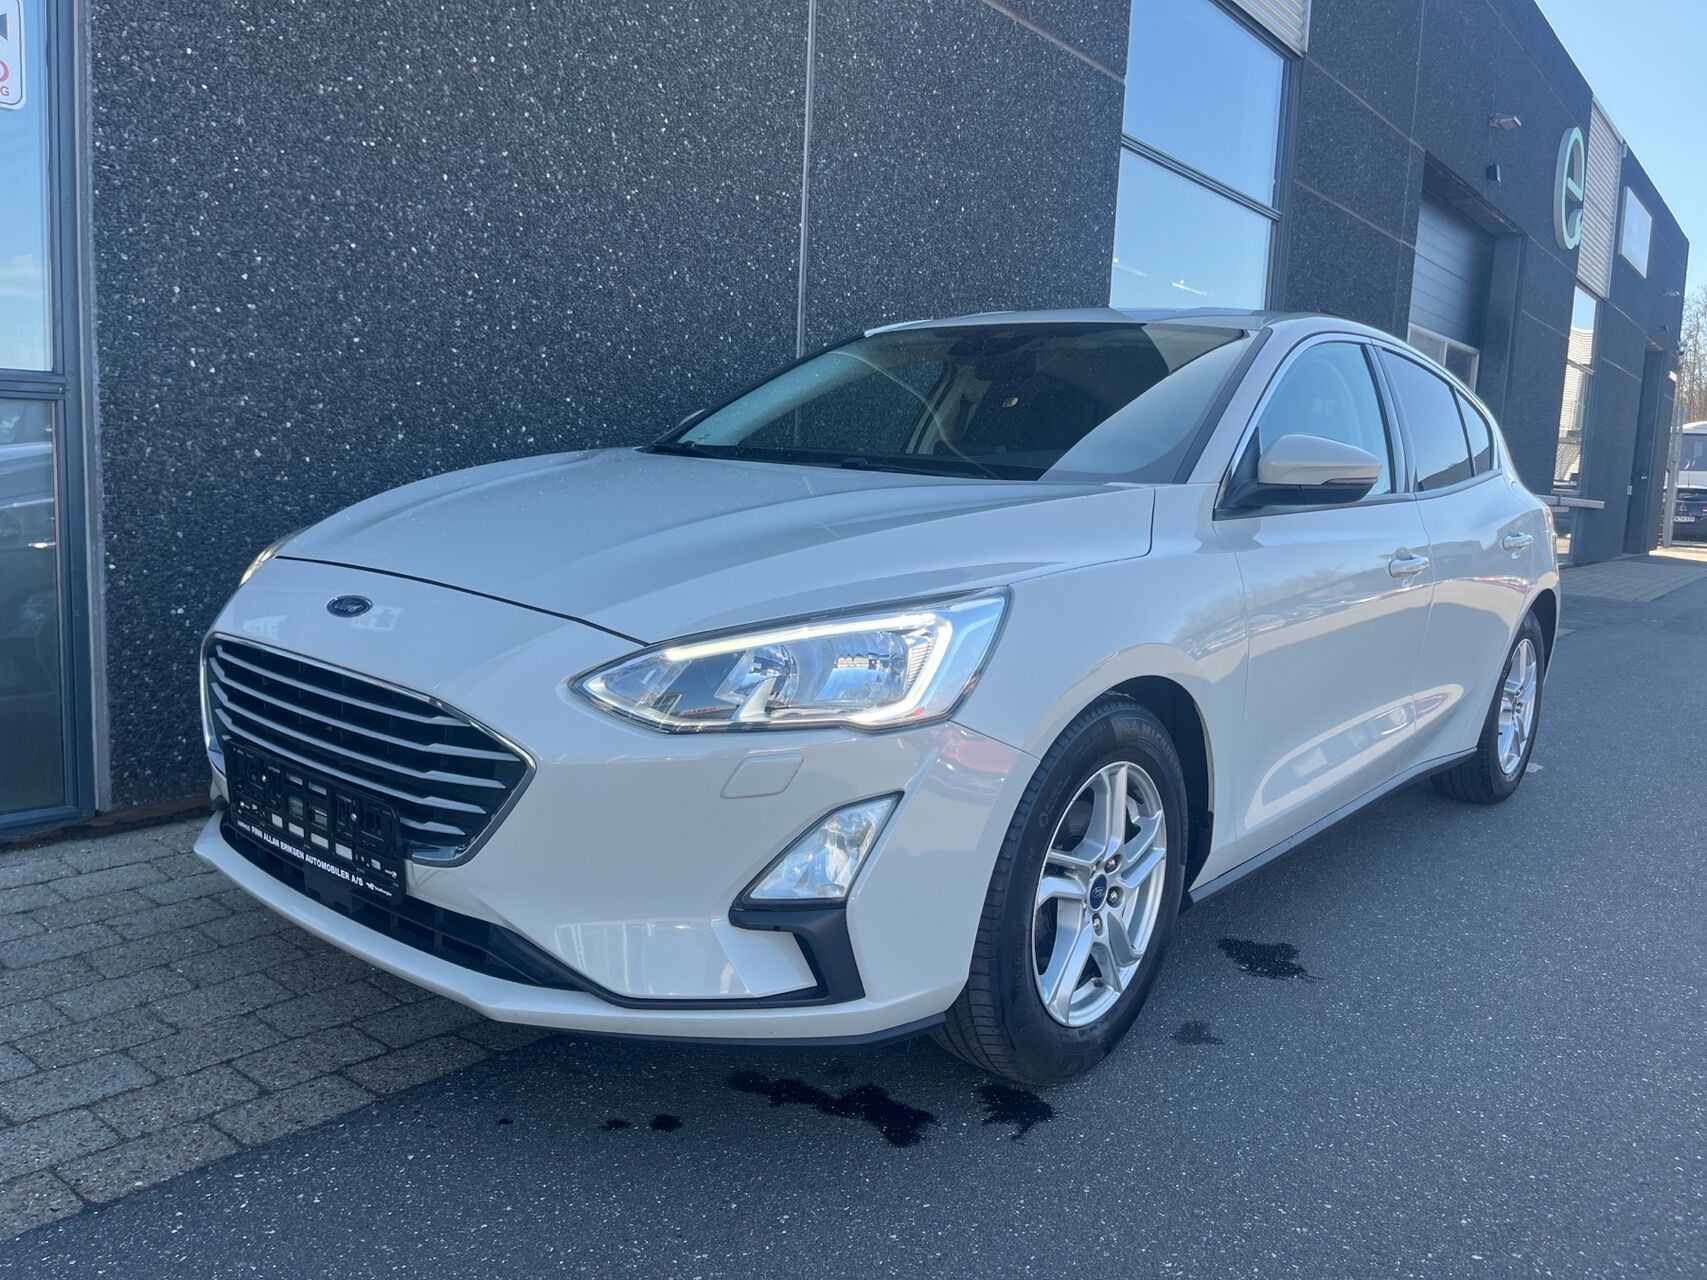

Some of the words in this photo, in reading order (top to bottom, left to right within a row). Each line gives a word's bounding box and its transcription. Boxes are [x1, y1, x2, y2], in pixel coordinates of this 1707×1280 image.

[263, 832, 280, 848] ALLAN
[280, 841, 305, 860] ERIKSEN
[305, 854, 350, 881] AUTOMOBILER
[351, 874, 364, 886] A/S
